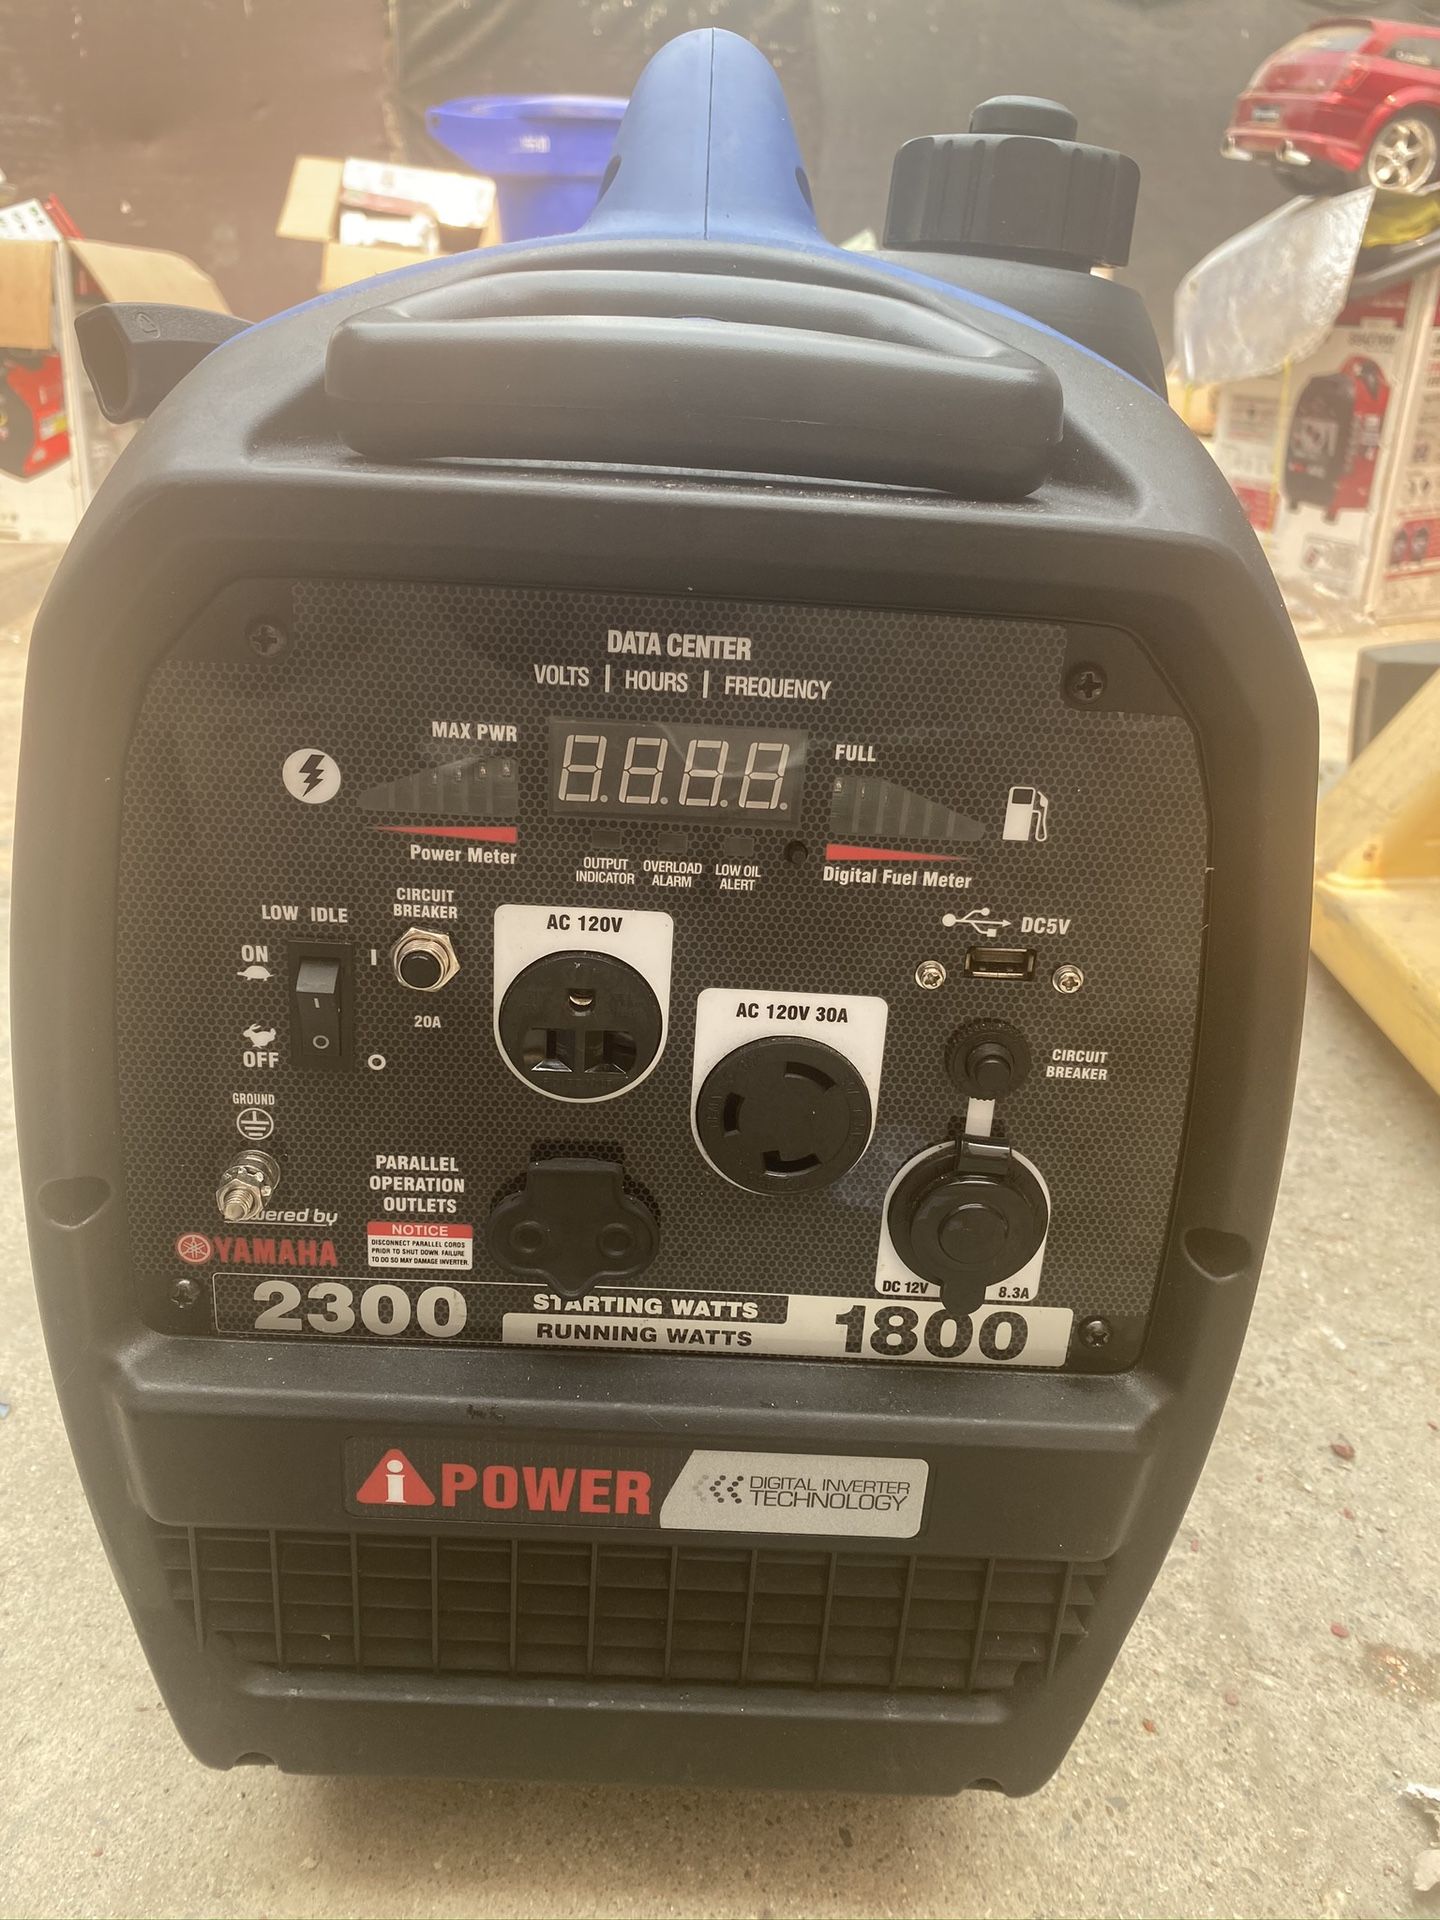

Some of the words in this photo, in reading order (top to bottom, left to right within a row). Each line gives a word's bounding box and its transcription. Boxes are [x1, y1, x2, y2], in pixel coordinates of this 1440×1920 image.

[607, 629, 661, 655] DATA
[667, 633, 752, 661] CENTER
[534, 664, 590, 687] VOLTS
[625, 670, 688, 693] HOURS
[724, 675, 832, 700] FREQUENCY
[432, 721, 471, 740] MAX
[477, 723, 518, 742] PWR
[834, 744, 876, 762] FULL
[410, 844, 461, 862] Power
[467, 847, 517, 865] Meter
[583, 856, 629, 871] OUTPUT
[643, 860, 703, 875] OVERLOAD
[715, 864, 741, 877] LOW
[743, 865, 761, 878] OIL
[576, 870, 635, 885] INDICATOR
[652, 875, 692, 888] ALARM
[720, 878, 755, 891] ALERT
[823, 865, 877, 885] Digital
[882, 868, 917, 886] Fuel
[923, 871, 972, 889] Meter
[396, 887, 455, 903] CIRCUIT
[261, 904, 298, 921] LOW
[310, 907, 348, 923] IDLE
[393, 904, 458, 919] BREAKER
[546, 914, 570, 932] AC
[578, 915, 623, 933] 120V
[1021, 916, 1071, 935] DC5V
[241, 945, 268, 962] ON
[736, 1002, 759, 1019] AC
[766, 1004, 810, 1021] 120V
[815, 1006, 848, 1023] 30A
[414, 1015, 441, 1029] 20A
[243, 1051, 279, 1068] OFF
[1052, 1048, 1108, 1064] CIRCUIT
[1046, 1065, 1108, 1081] BREAKER
[232, 1092, 275, 1106] GROUND
[375, 1155, 459, 1172] PARALLEL
[369, 1175, 465, 1193] OPERATION
[383, 1197, 457, 1214] OUTLETS
[313, 1208, 338, 1226] by
[391, 1224, 449, 1236] NOTICE
[213, 1236, 338, 1267] YAMAHA
[412, 1240, 442, 1248] PARALLEL
[441, 1249, 465, 1257] FAILURE
[882, 1280, 901, 1293] DC
[904, 1281, 929, 1295] 12V
[998, 1286, 1030, 1300] 8.3A
[253, 1280, 467, 1337] 2300
[533, 1293, 663, 1315] STARTING
[671, 1299, 759, 1319] WATTS
[537, 1323, 657, 1343] RUNNING
[666, 1328, 752, 1347] WATTS
[835, 1304, 1028, 1361] 1800
[442, 1463, 651, 1515] POWER
[750, 1476, 817, 1491] DIGITAL
[822, 1479, 911, 1495] INVERTER
[750, 1489, 908, 1511] TECHNOLOGY
